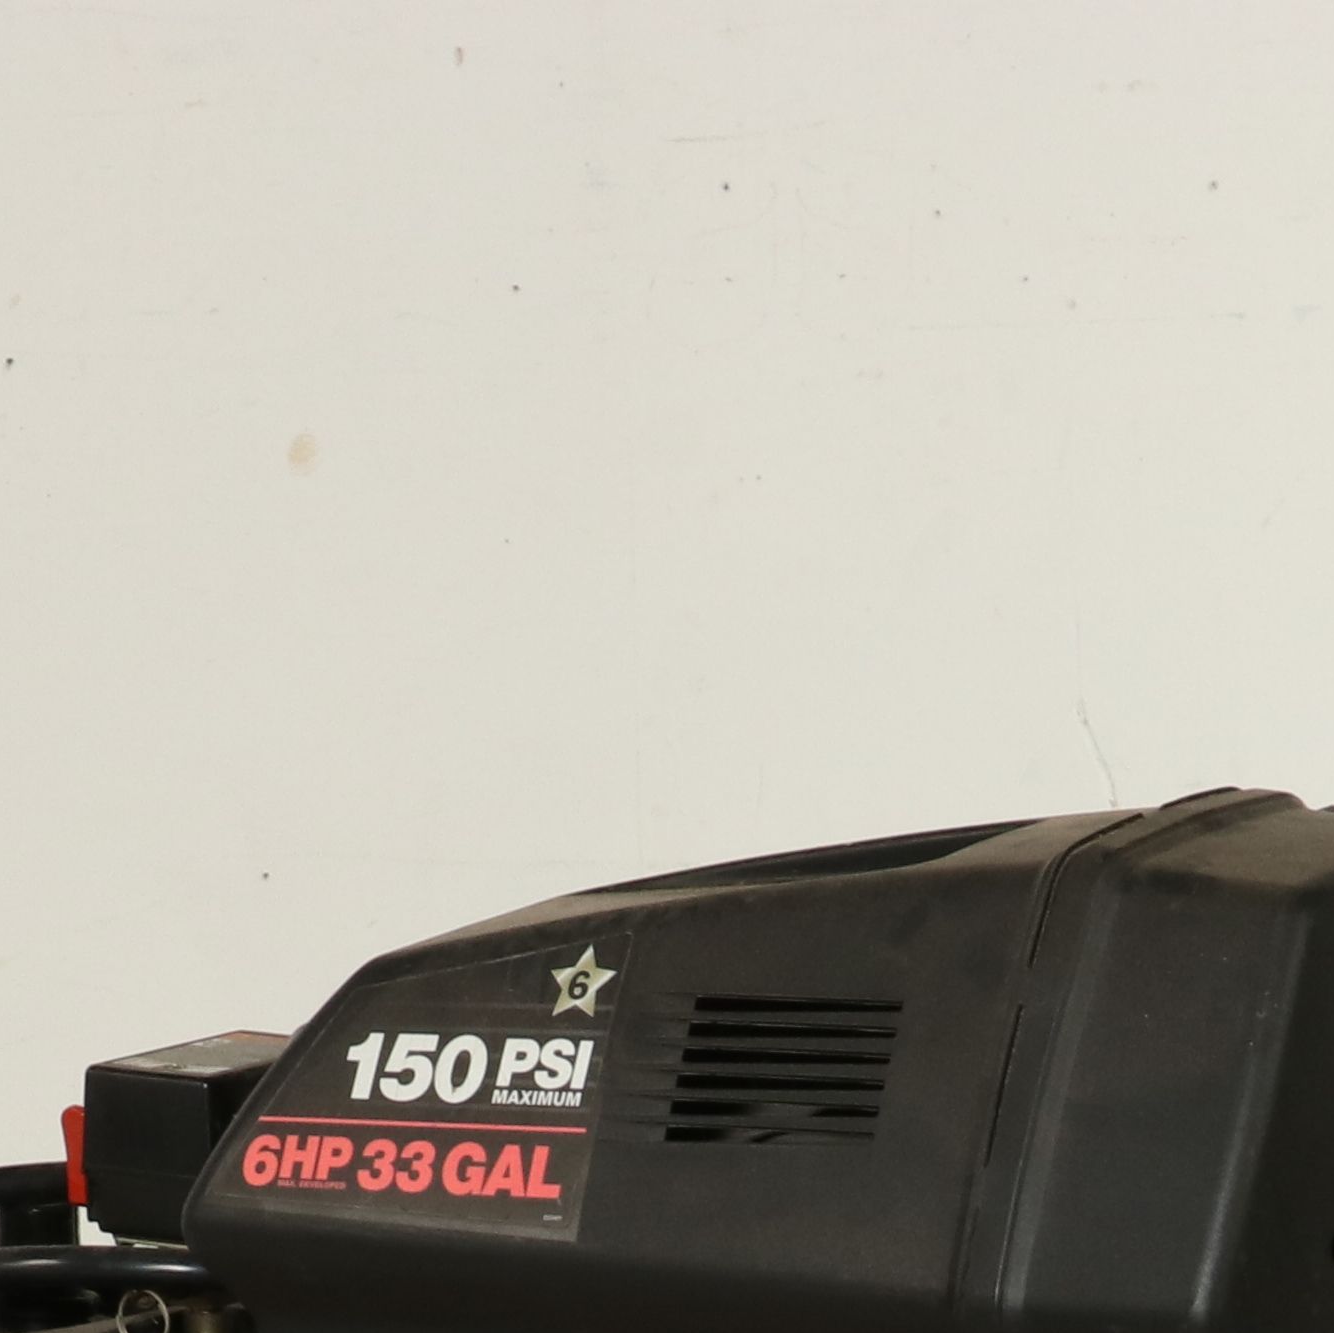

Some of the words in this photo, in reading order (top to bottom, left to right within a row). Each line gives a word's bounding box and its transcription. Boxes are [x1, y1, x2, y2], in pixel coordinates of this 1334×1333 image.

[568, 970, 591, 1000] 6
[346, 1032, 488, 1104] 150
[495, 1037, 594, 1090] PSI
[492, 1089, 582, 1107] MAXIMUM
[242, 1134, 354, 1187] 6HP
[357, 1138, 436, 1194] 33
[442, 1140, 562, 1199] GAL
